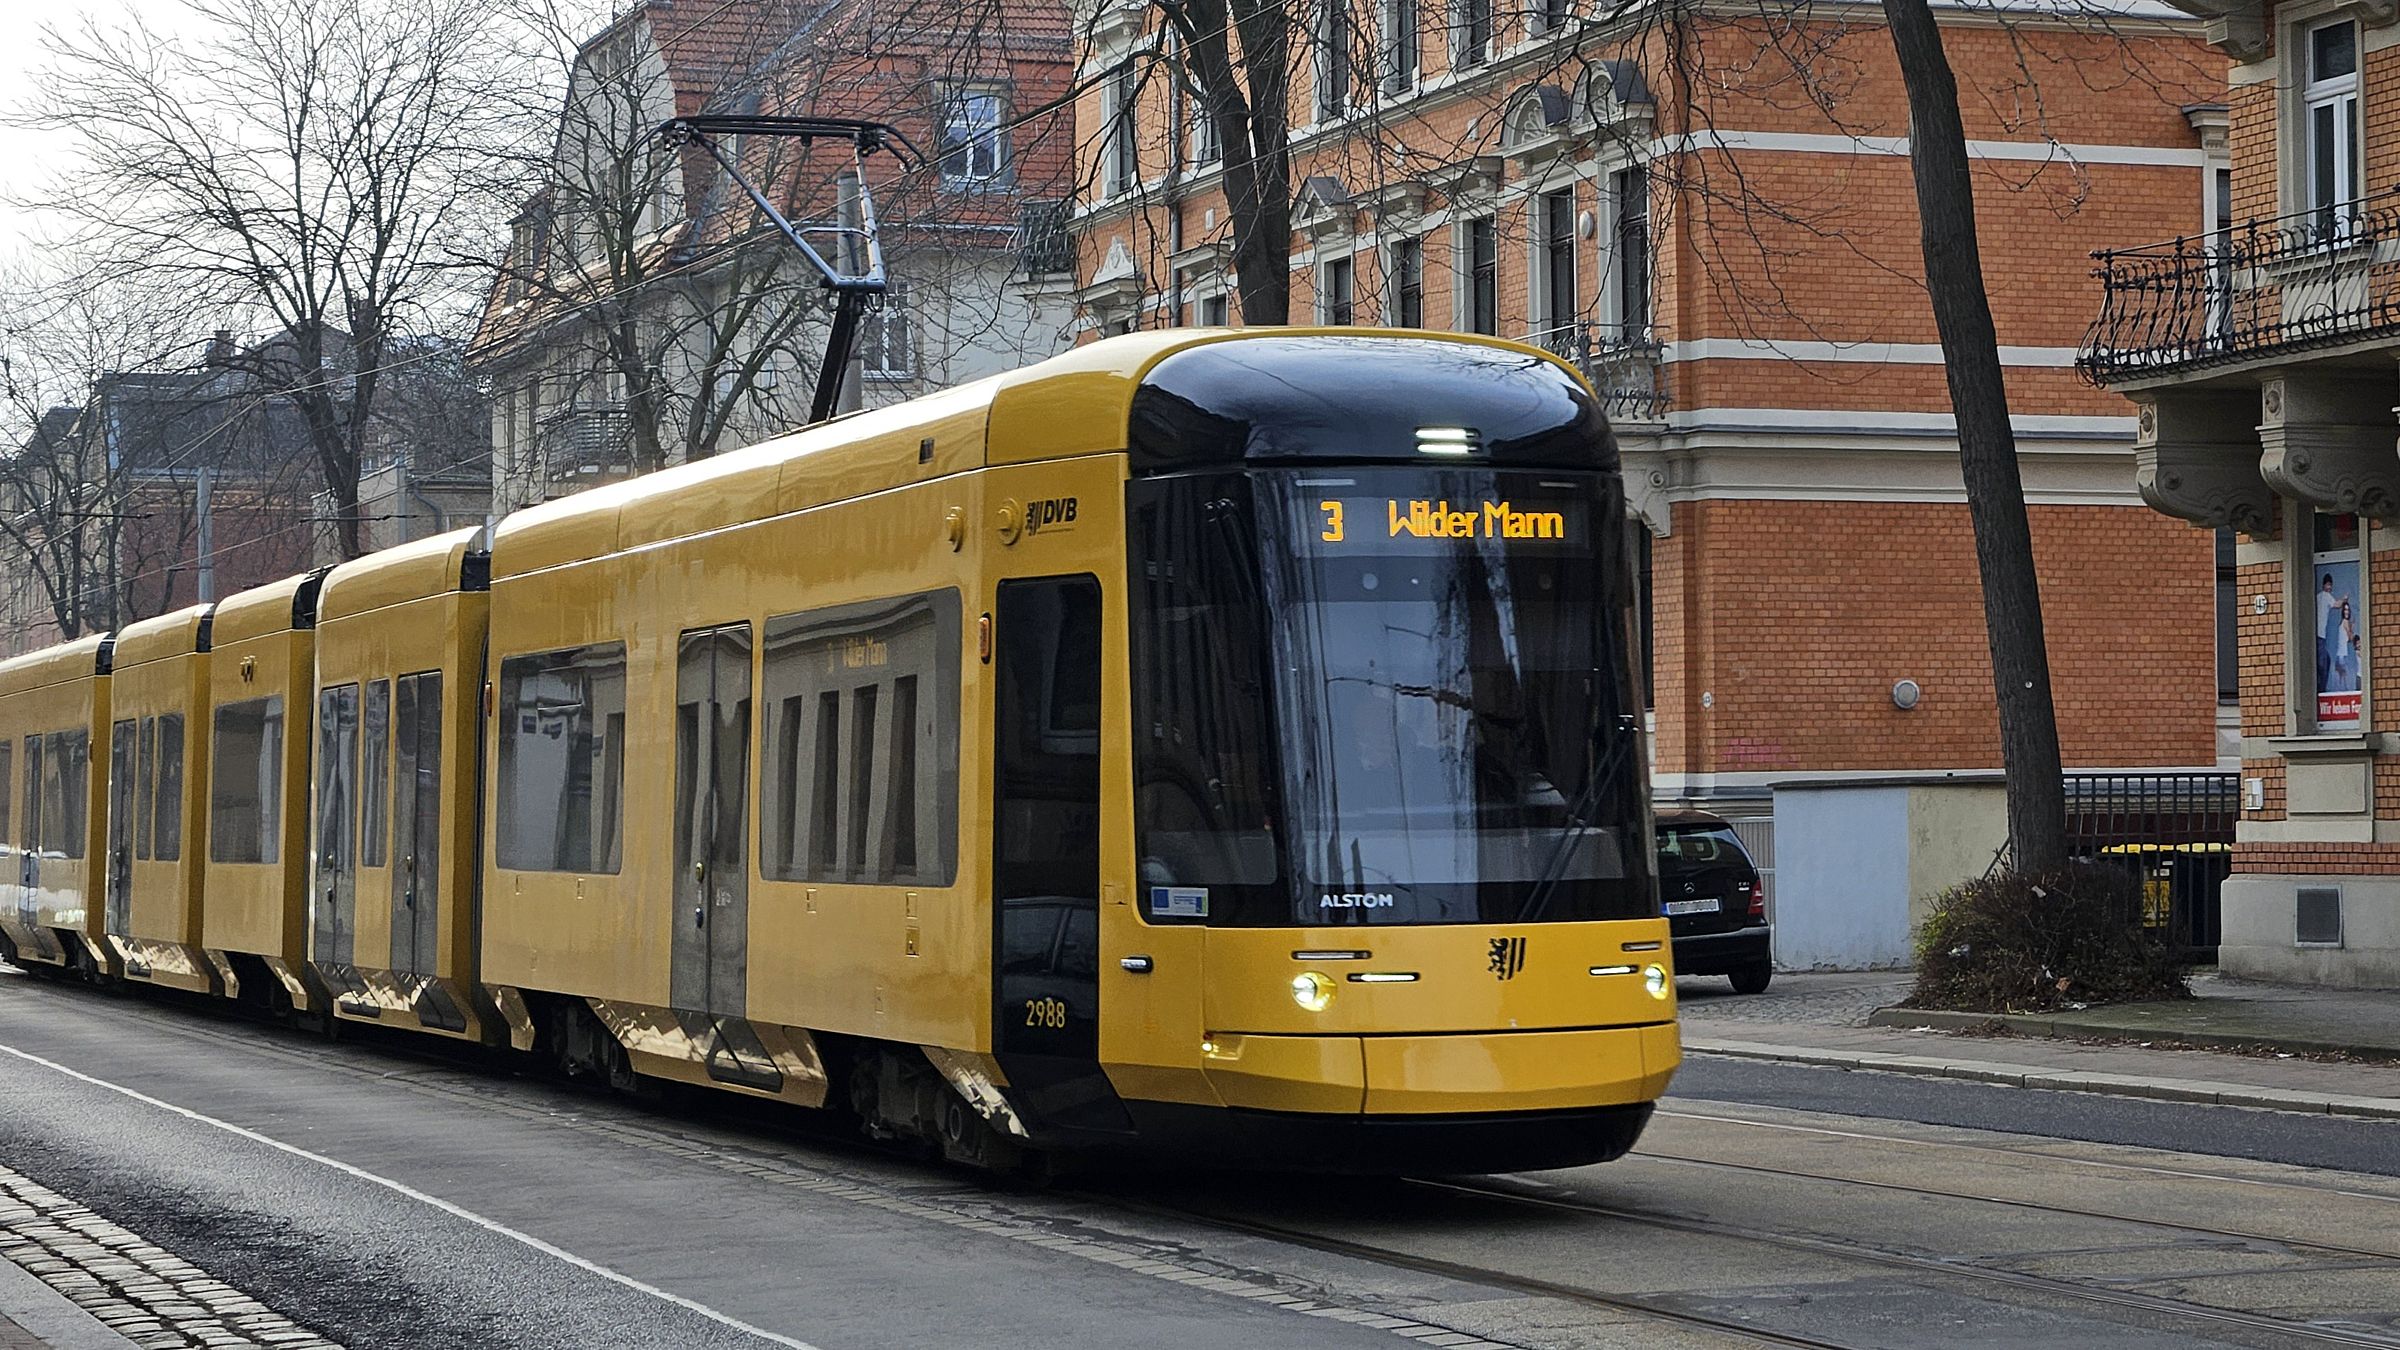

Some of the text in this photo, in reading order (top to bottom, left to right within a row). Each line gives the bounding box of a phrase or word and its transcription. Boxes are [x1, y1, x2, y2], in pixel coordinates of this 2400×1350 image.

[1043, 497, 1077, 524] DVB
[1321, 500, 1563, 541] 3 Wilder Mann
[1026, 999, 1065, 1028] 2988
